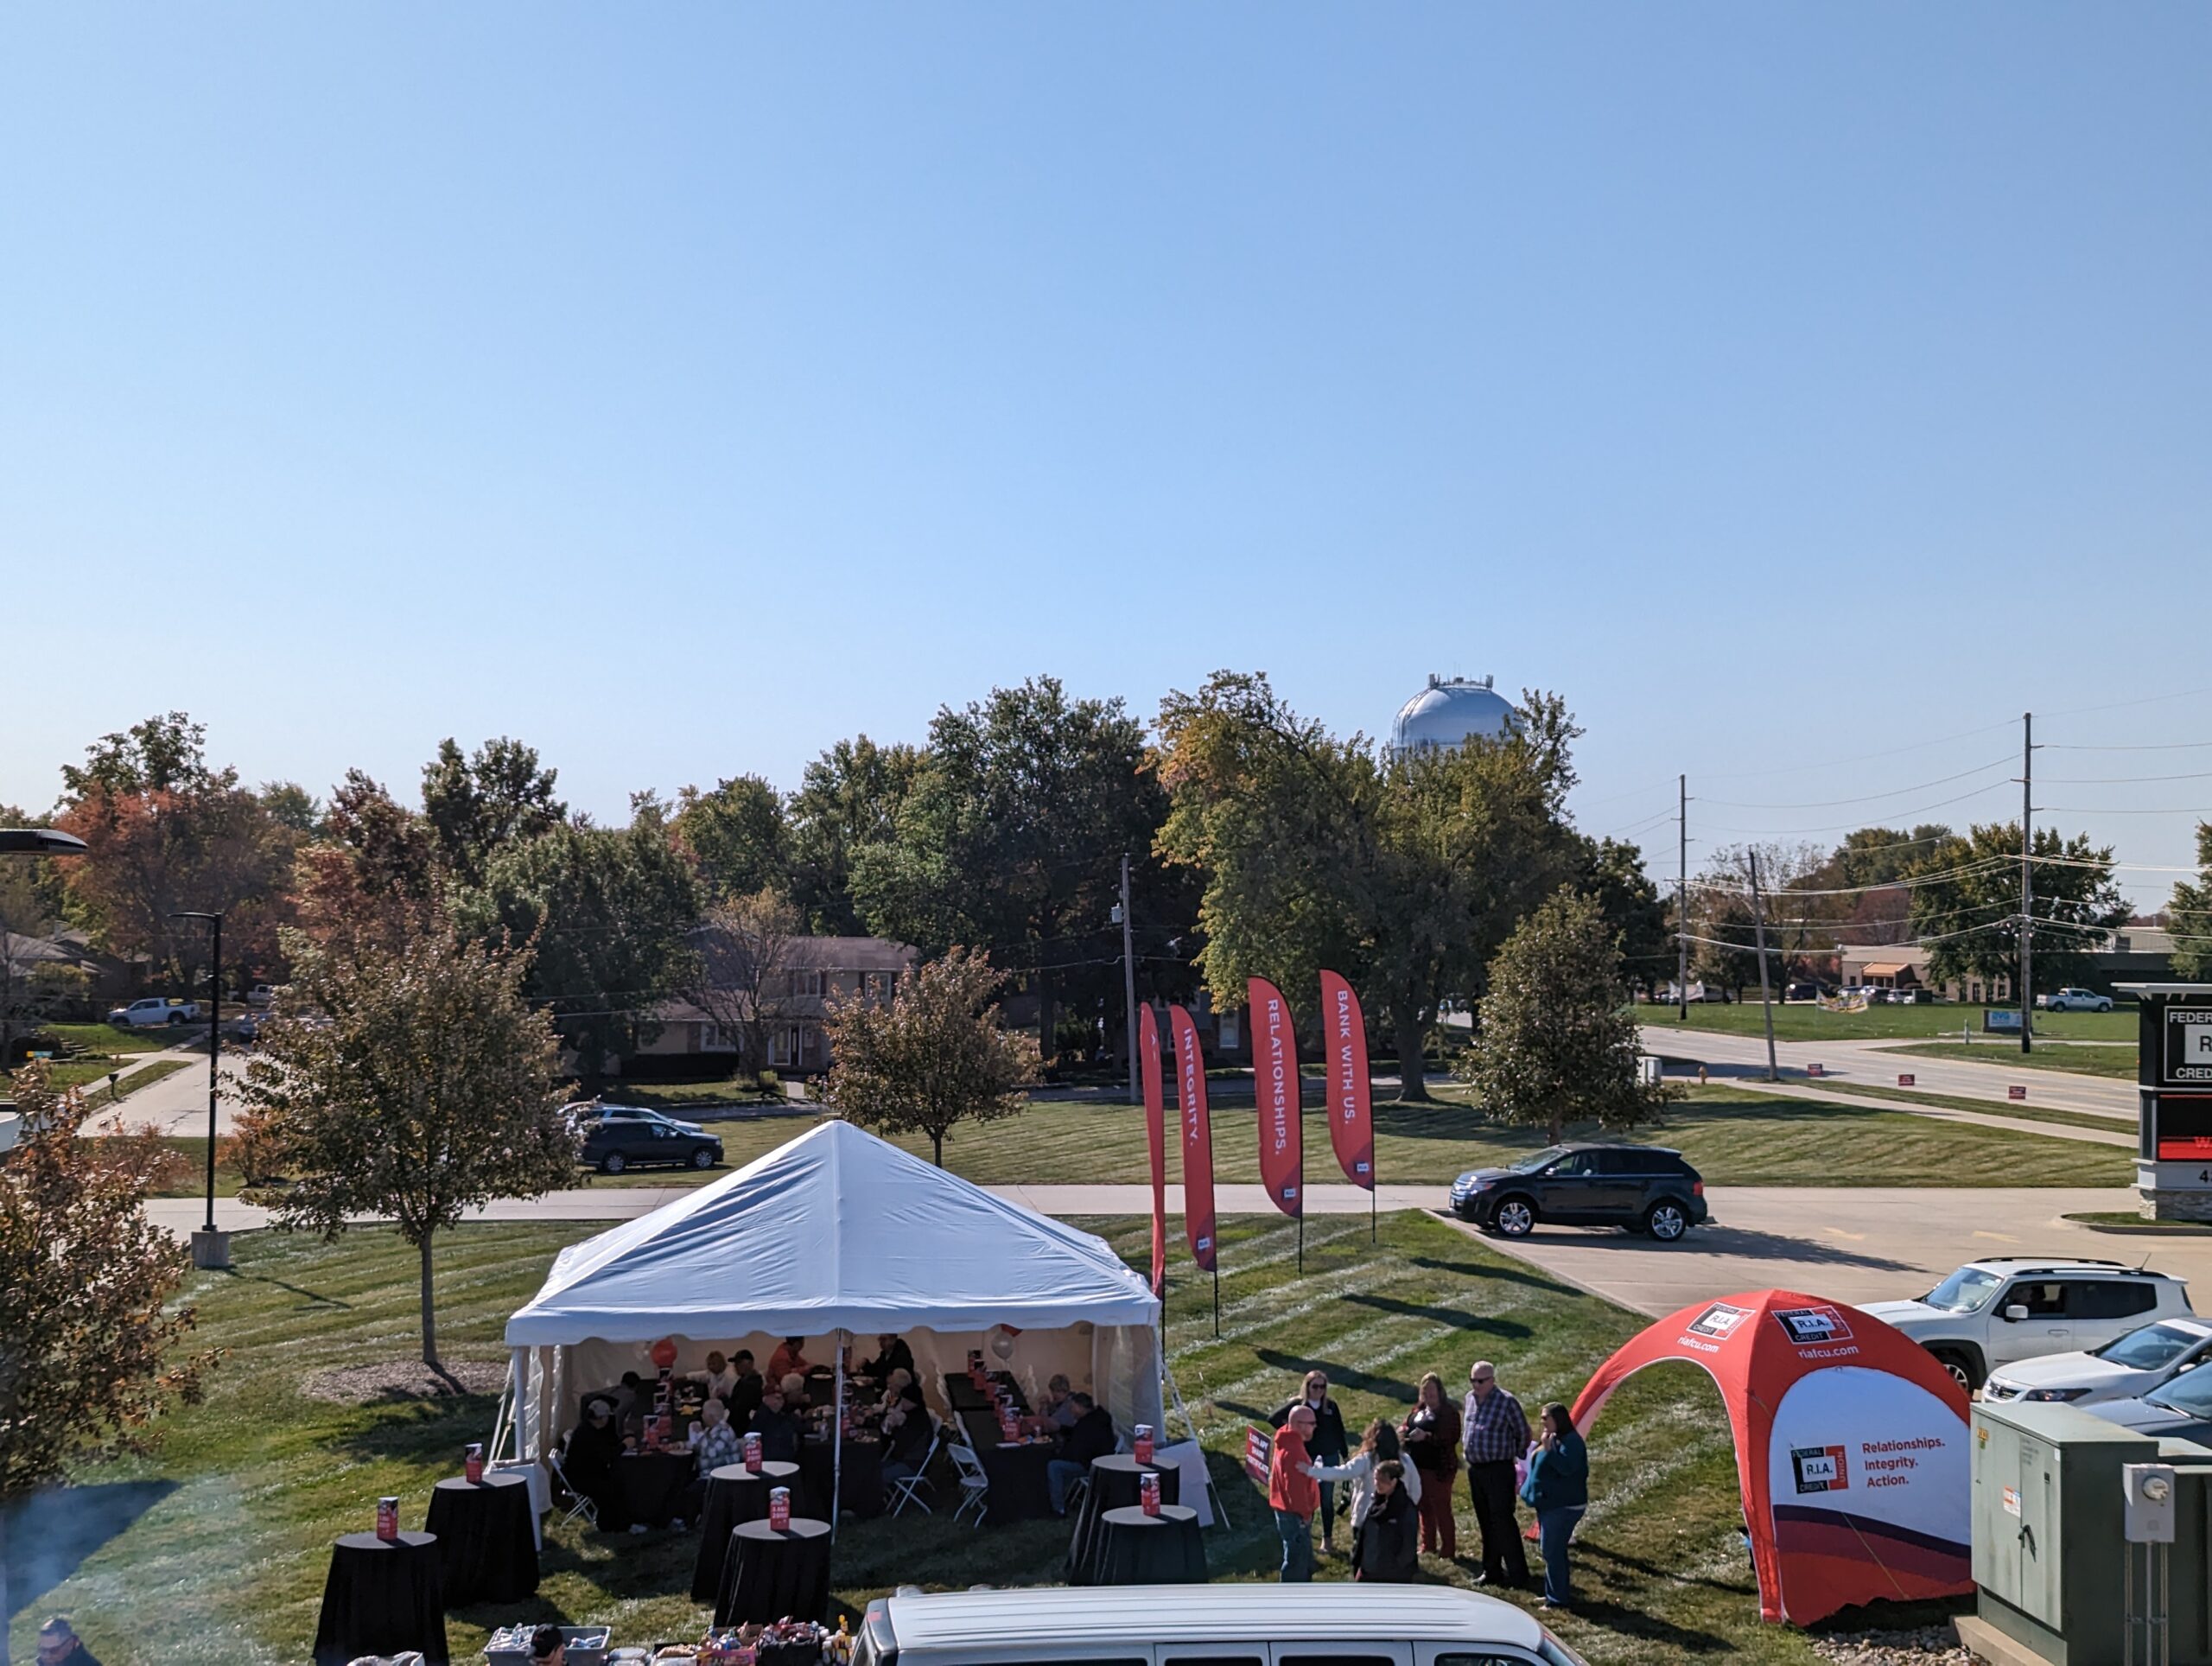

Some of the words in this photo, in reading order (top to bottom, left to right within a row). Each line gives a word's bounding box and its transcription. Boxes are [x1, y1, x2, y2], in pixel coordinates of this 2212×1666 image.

[1337, 990, 1351, 1038] BANK
[2169, 1012, 2212, 1023] FEDER
[1340, 1045, 1355, 1091] WITH
[2176, 1067, 2212, 1079] CRED
[1268, 999, 1287, 1155] RELATIONSHIPS.
[1183, 1027, 1198, 1147] INTEGRITY.
[1343, 1097, 1356, 1124] US.
[2198, 1169, 2212, 1183] 4
[1693, 1324, 1714, 1333] CREDIT
[1797, 1319, 1829, 1328] R.I.A.
[1795, 1332, 1824, 1341] CREDIT
[1677, 1337, 1719, 1353] riafcu.com
[1798, 1345, 1859, 1359] riafcu.com
[1862, 1437, 1946, 1453] Relationships.
[1806, 1462, 1833, 1475] R.I.A.
[1837, 1451, 1847, 1483] UNION
[1865, 1457, 1918, 1471] Integrity.
[1866, 1474, 1910, 1488] Action.
